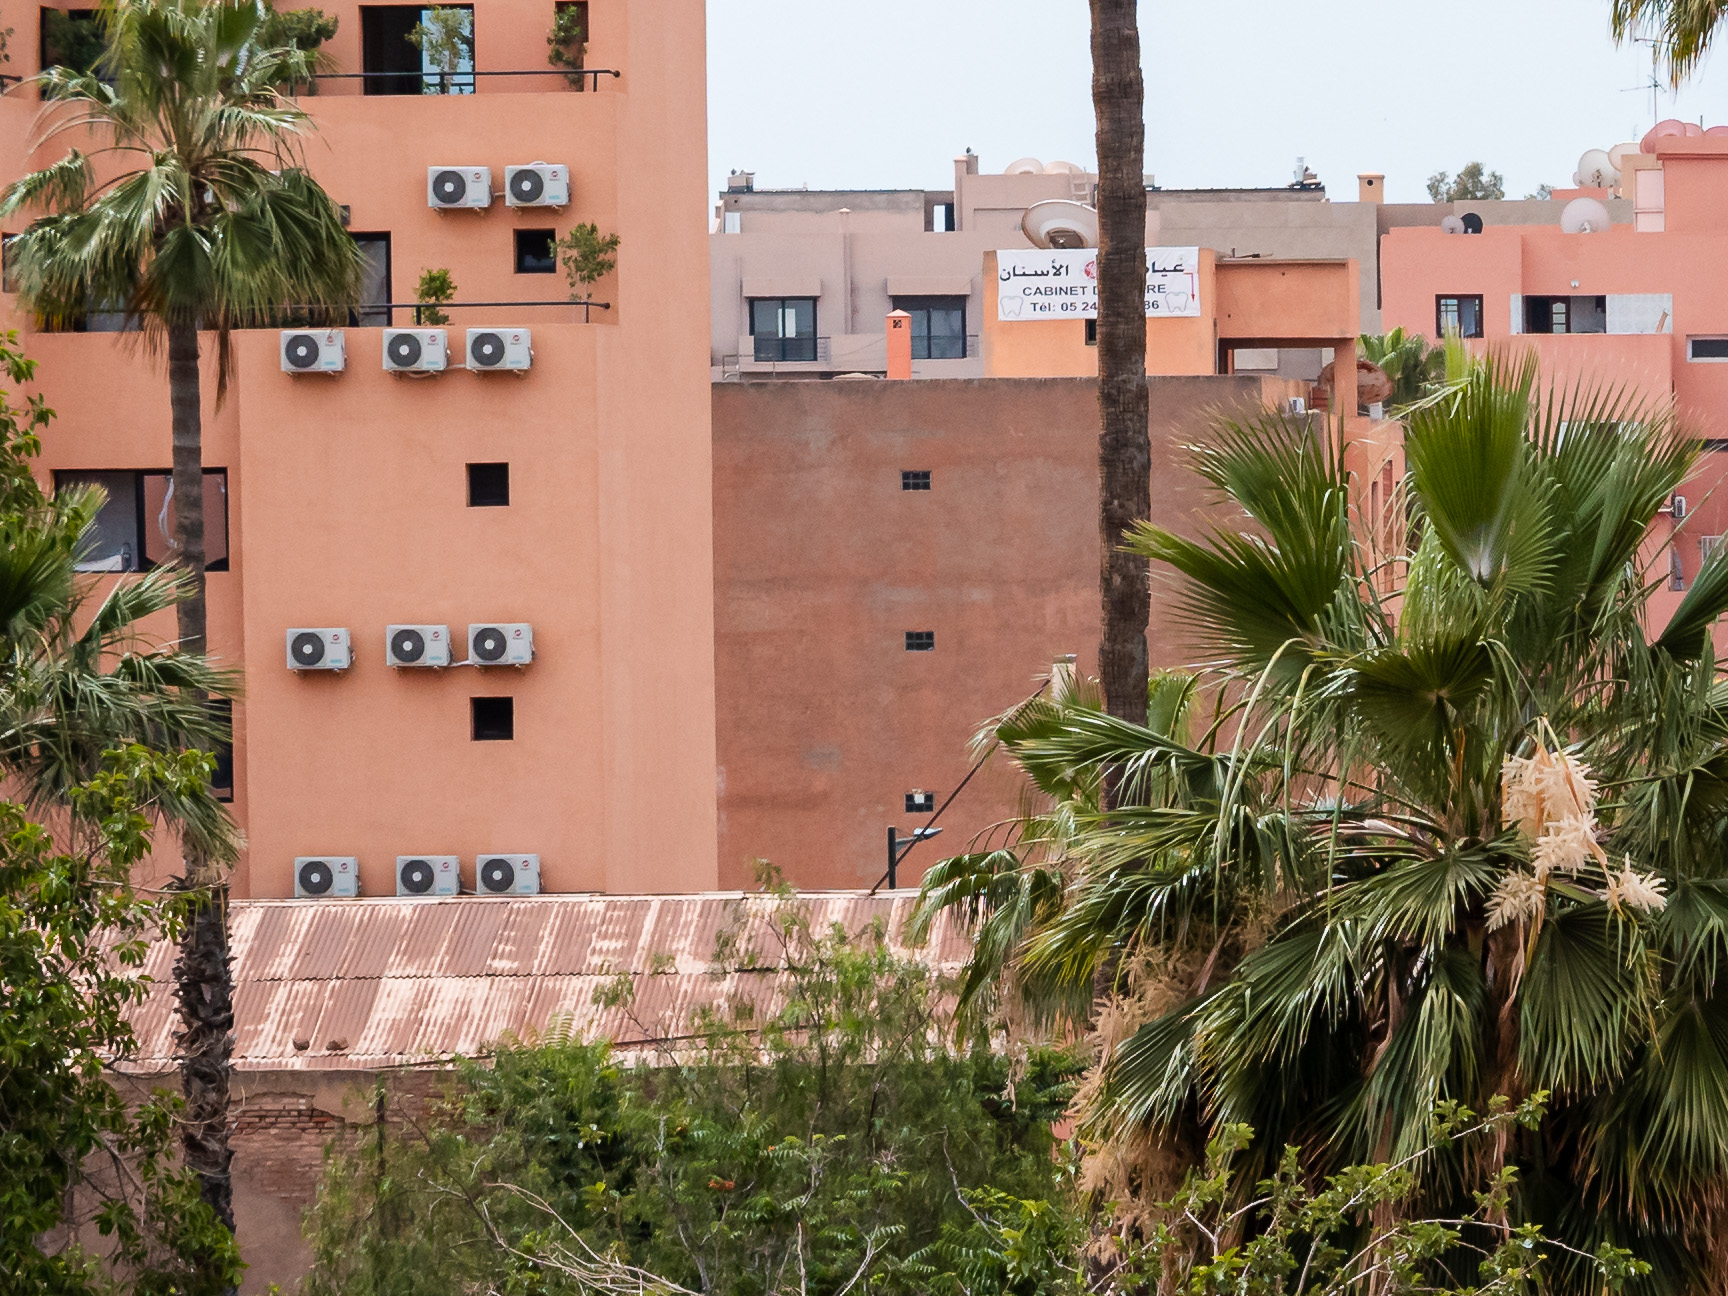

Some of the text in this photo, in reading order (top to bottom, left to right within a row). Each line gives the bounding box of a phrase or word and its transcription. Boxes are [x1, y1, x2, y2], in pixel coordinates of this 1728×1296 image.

[1000, 259, 1068, 281] الأسنان
[1022, 286, 1087, 296] CABINET
[1030, 301, 1055, 311] Tél:
[1061, 302, 1077, 311] 05
[1081, 301, 1097, 311] 24
